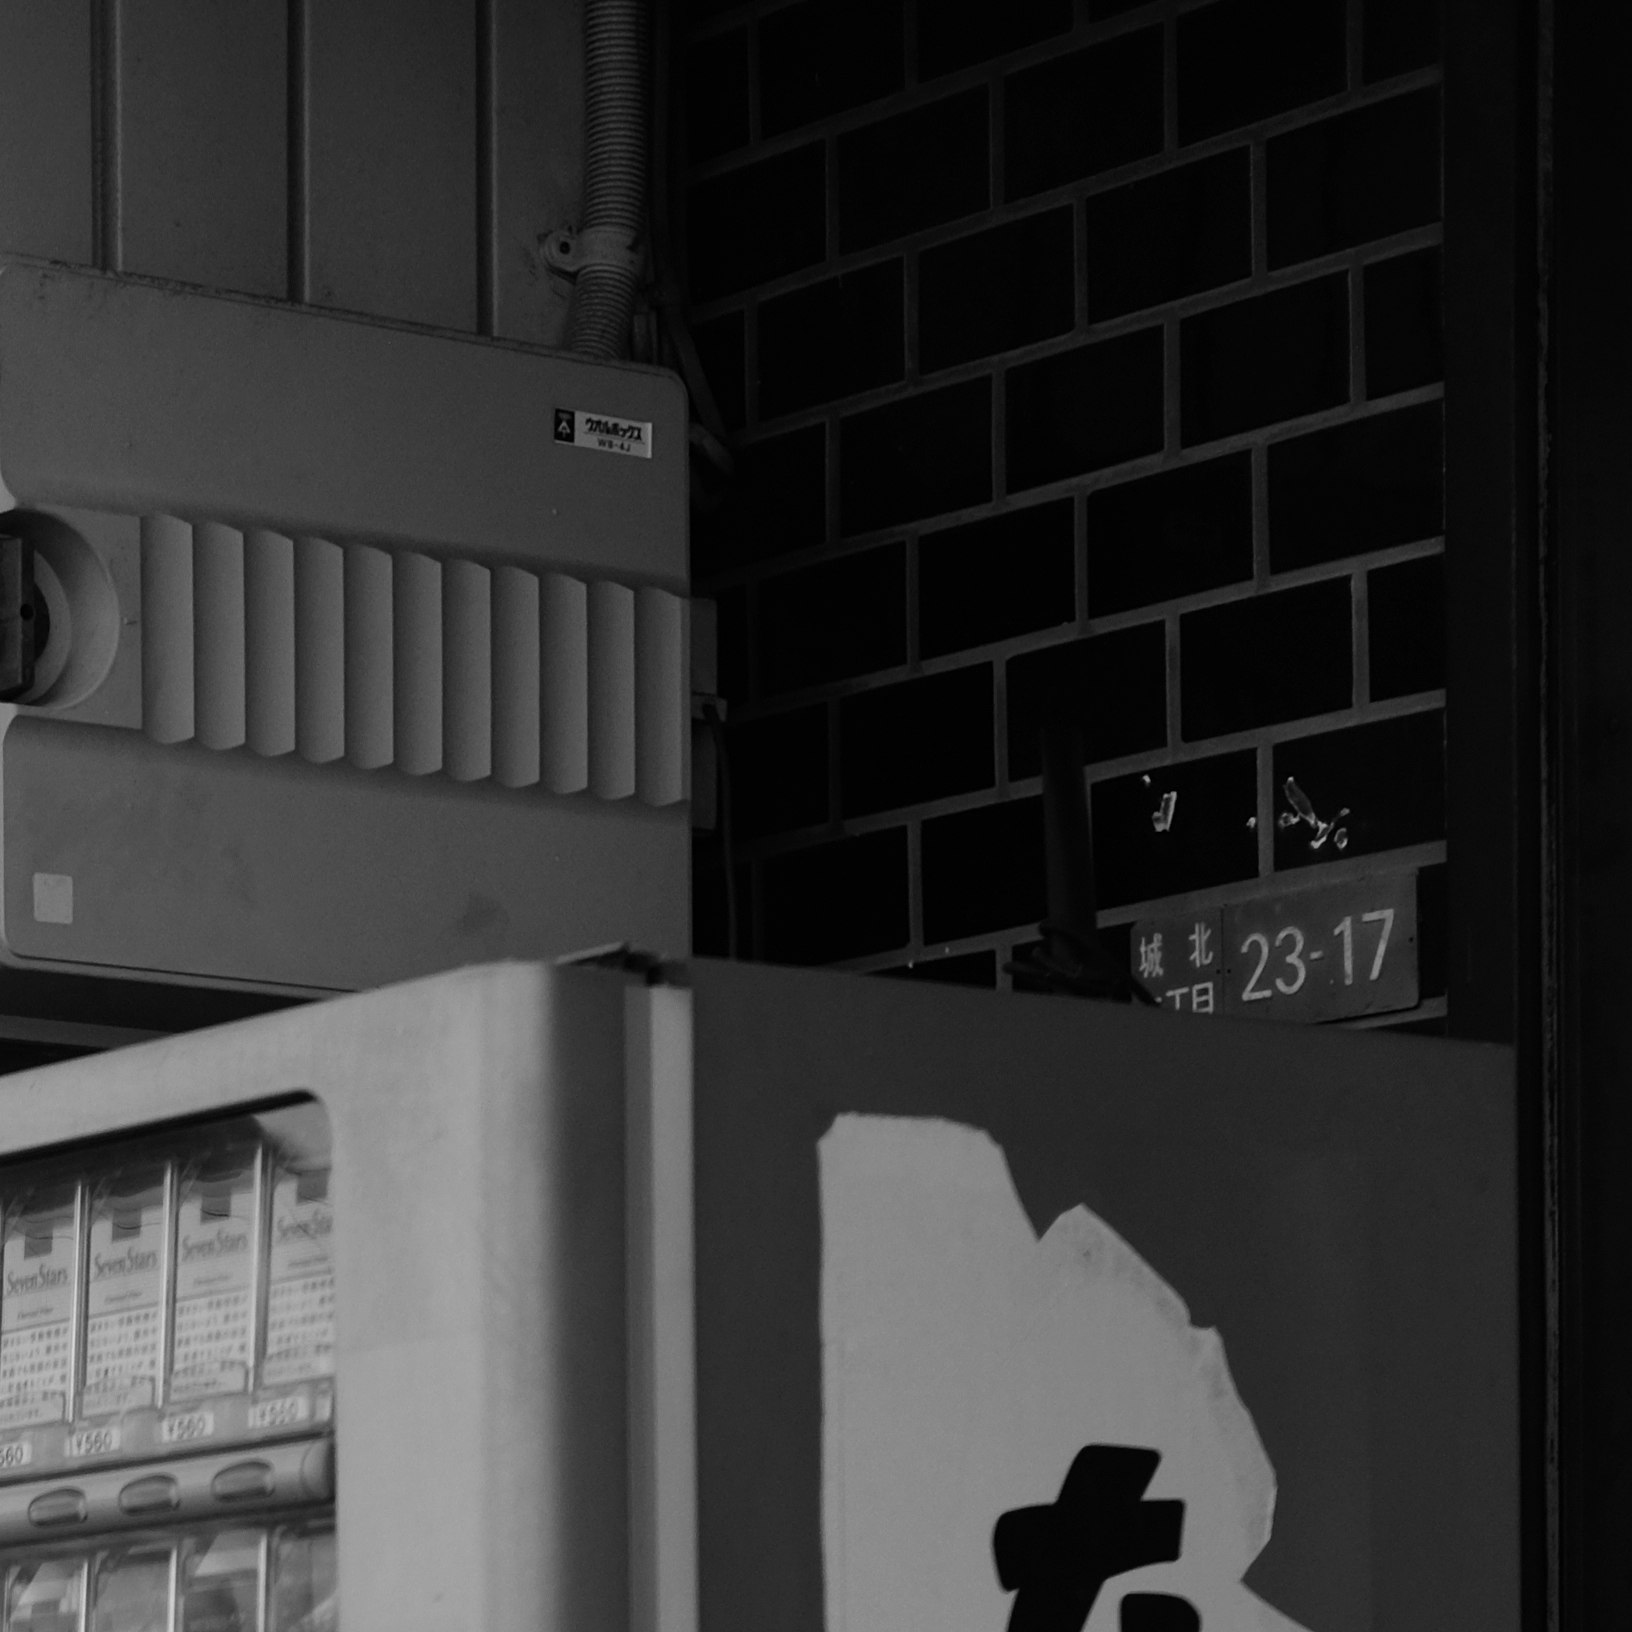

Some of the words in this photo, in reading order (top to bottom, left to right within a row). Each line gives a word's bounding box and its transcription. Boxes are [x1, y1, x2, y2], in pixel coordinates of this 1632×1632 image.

[1138, 920, 1214, 979] 城北
[1239, 907, 1395, 1003] 23-17
[1153, 980, 1215, 1015] 丁目
[74, 1430, 113, 1454] ¥560
